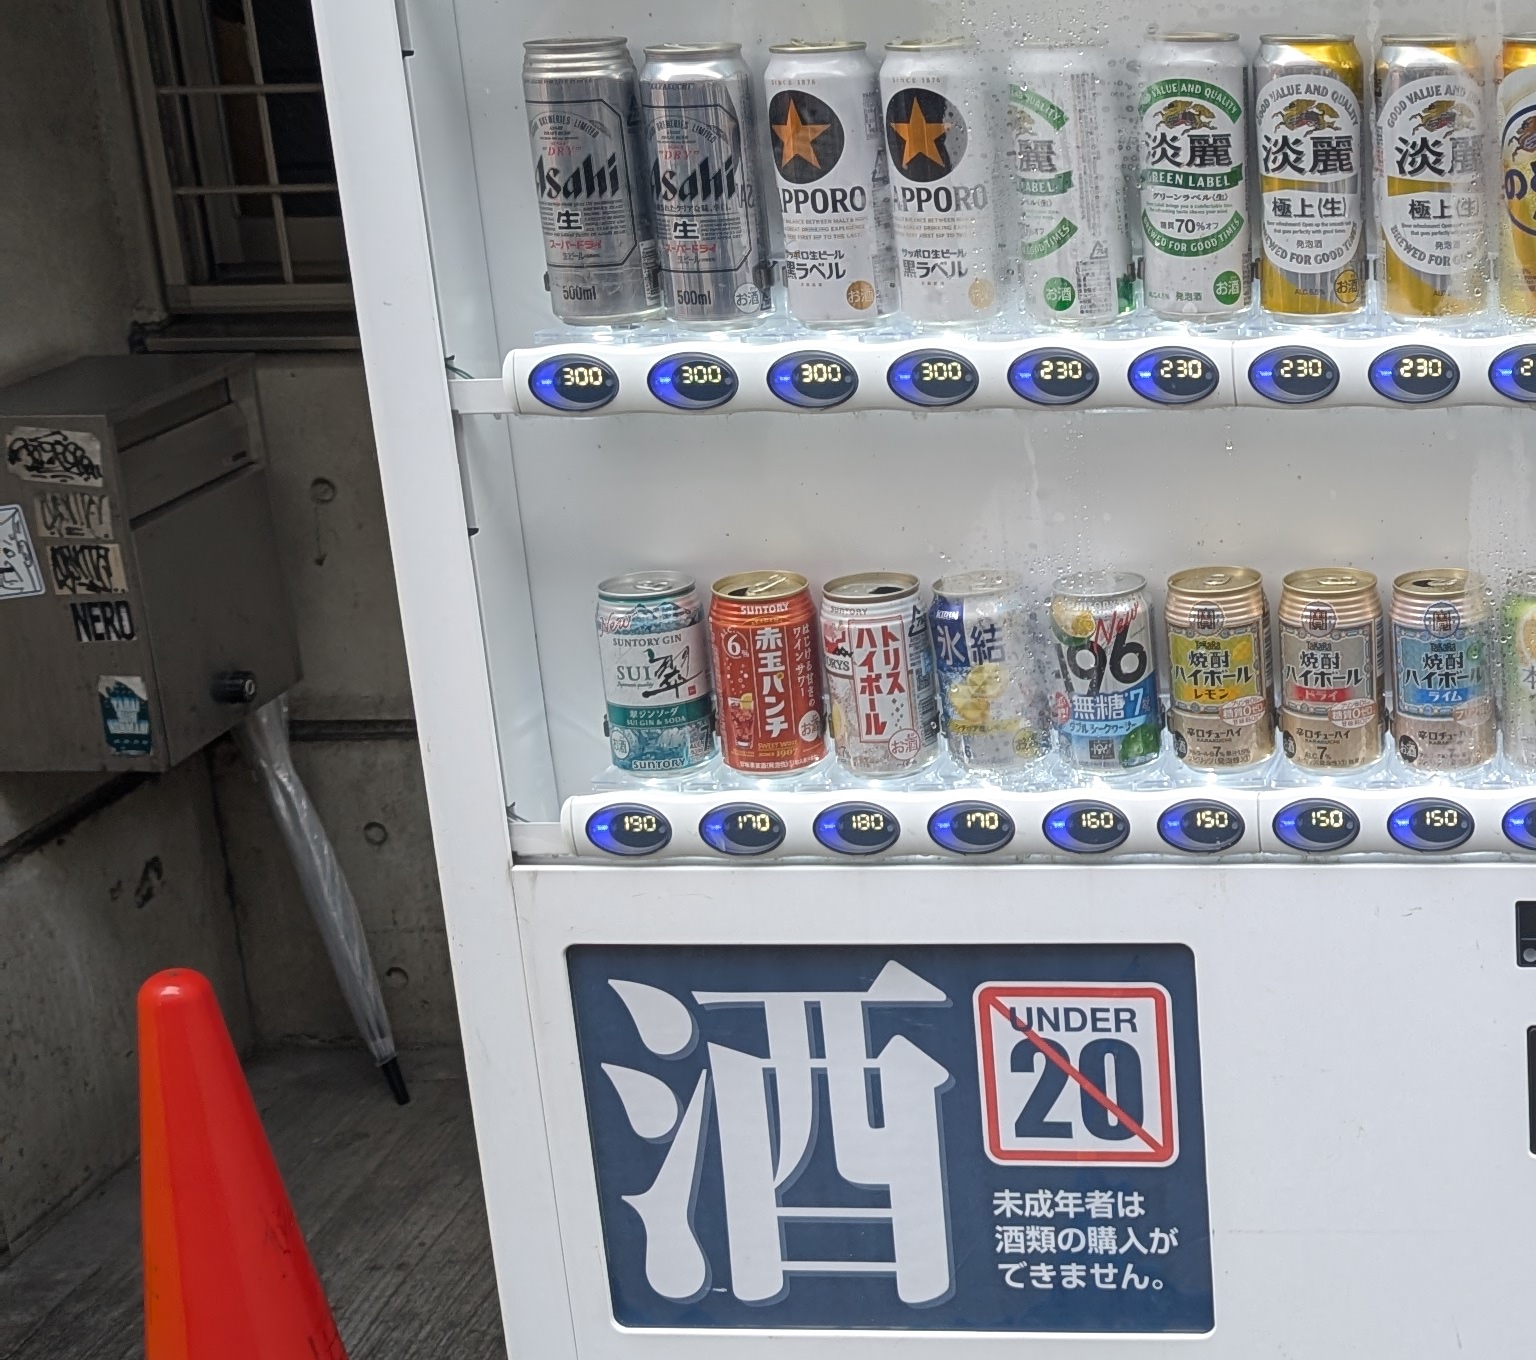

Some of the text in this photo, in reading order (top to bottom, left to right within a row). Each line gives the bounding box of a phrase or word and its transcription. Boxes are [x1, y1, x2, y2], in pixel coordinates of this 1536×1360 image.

[1145, 131, 1235, 169] 淡麗
[1262, 135, 1355, 175] 淡麗
[557, 210, 583, 231] 生
[673, 219, 700, 240] 生
[562, 285, 597, 303] 500ml
[677, 289, 713, 307] 500ml
[562, 366, 603, 386] 300
[681, 364, 722, 384] 300
[801, 363, 842, 383] 300
[1040, 360, 1083, 380] 230
[1279, 358, 1322, 378] 230
[1399, 358, 1442, 378] 230
[740, 602, 790, 615] SUNTORY
[70, 599, 137, 642] NERO
[937, 623, 1006, 666] 氷結
[881, 624, 906, 696] トリス
[1188, 650, 1231, 668] 焼酎
[1299, 650, 1341, 670] 焼酎
[1421, 652, 1465, 670] 焼酎
[754, 627, 790, 740] 赤玉パンチ
[855, 626, 888, 736] ハイボール
[1174, 665, 1254, 687] ハイボール
[1284, 664, 1364, 688] ハイボール
[1193, 688, 1230, 700] レモン
[1072, 694, 1126, 721] 無糖
[632, 758, 686, 769] SUNTORY
[623, 812, 657, 832] 190
[850, 811, 884, 831] 180
[965, 810, 999, 830] 170
[1080, 809, 1114, 829] 160
[1195, 808, 1229, 828] 150
[1312, 808, 1346, 828] 150
[1009, 1006, 1138, 1034] UNDER
[1009, 1037, 1146, 1141] 20
[600, 958, 956, 1306] 酒
[993, 1189, 1147, 1219] 未成年者は
[995, 1224, 1180, 1256] 酒類の購入が
[997, 1261, 1166, 1291] できません。
